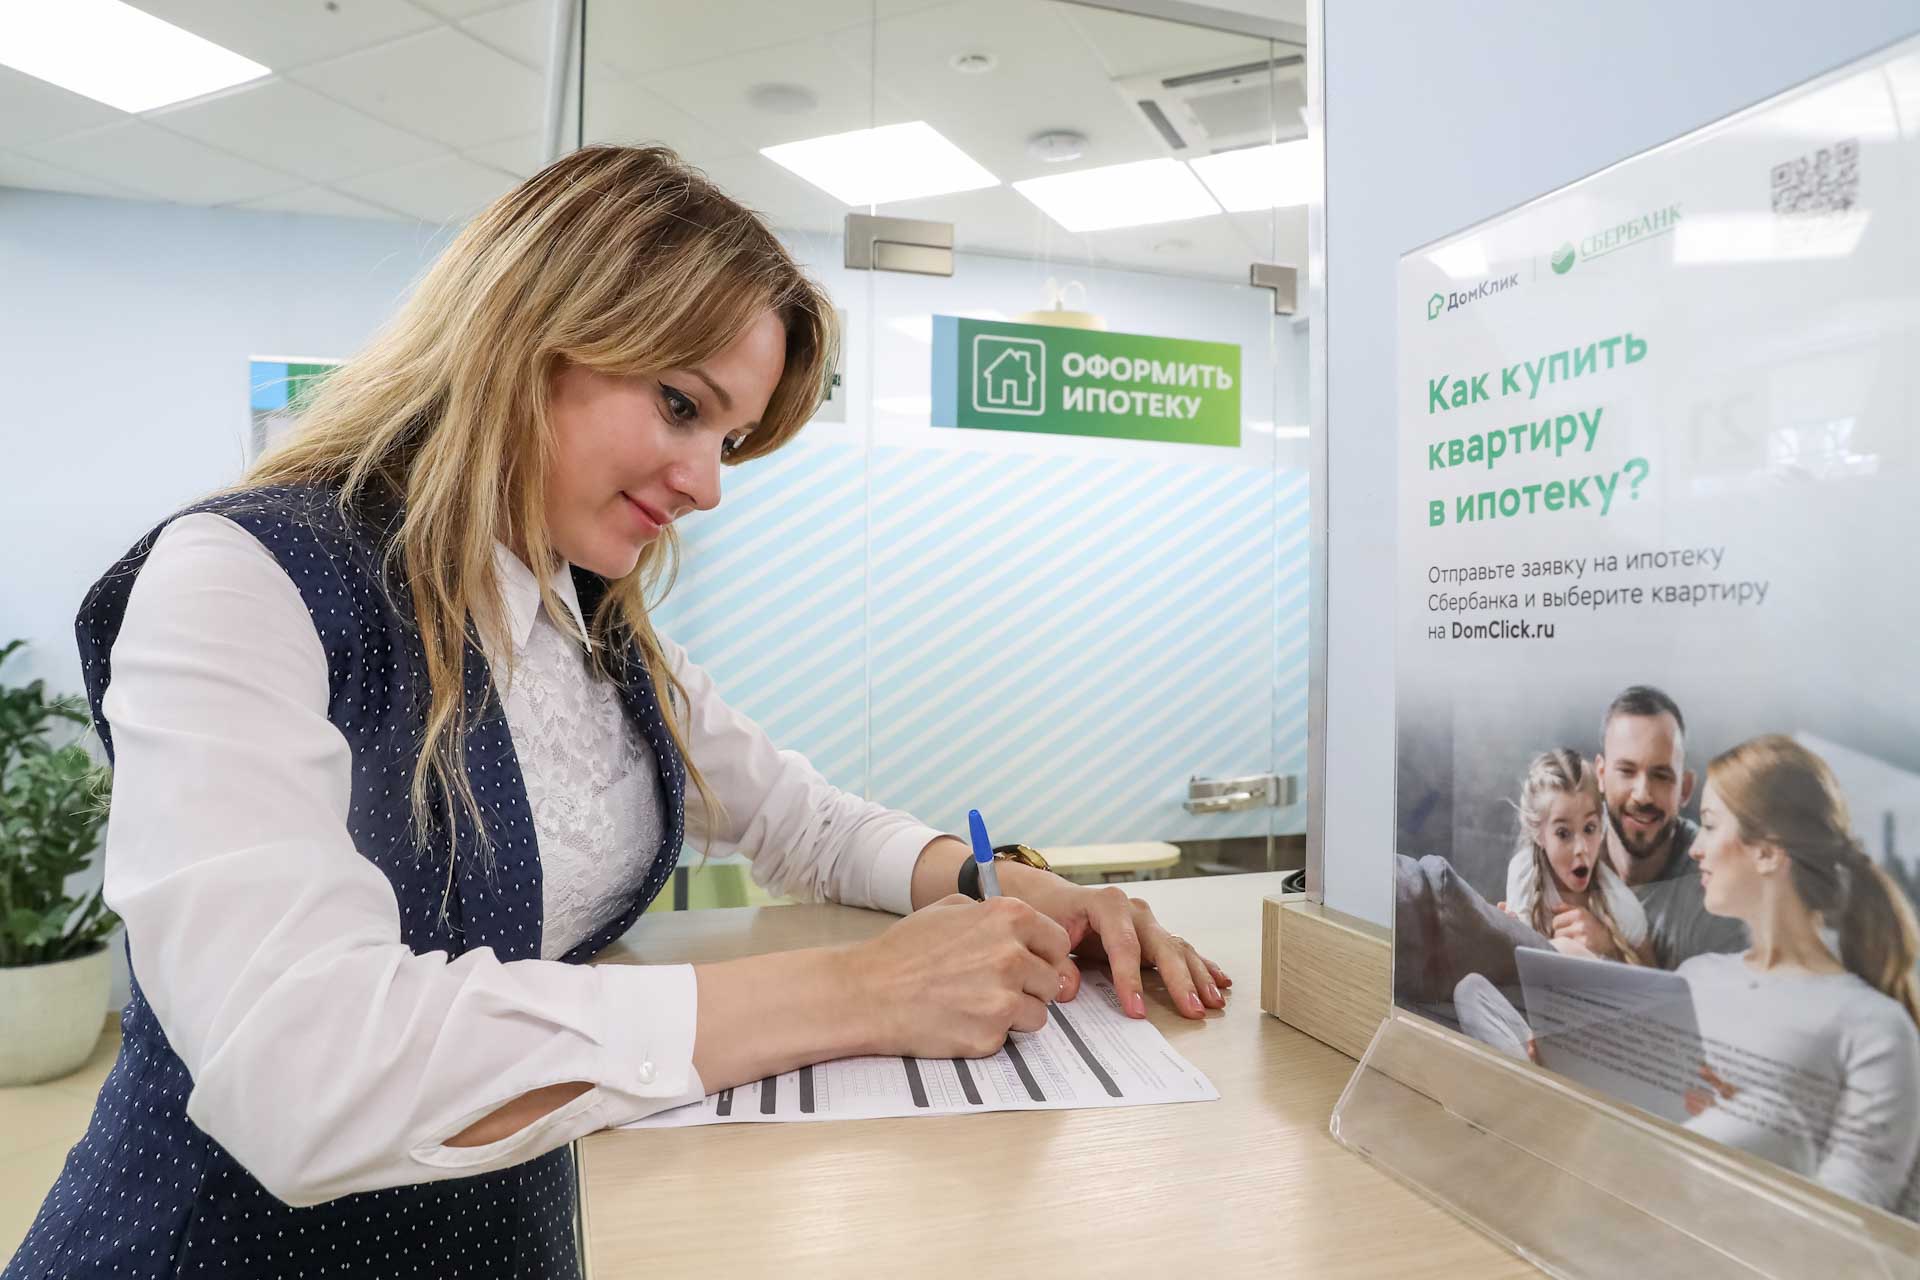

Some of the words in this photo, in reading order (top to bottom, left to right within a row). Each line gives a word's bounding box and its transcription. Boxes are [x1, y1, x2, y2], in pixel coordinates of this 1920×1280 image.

[1580, 202, 1683, 258] СБЕРБАНК
[1447, 272, 1519, 312] ДомКлик
[1061, 351, 1234, 390] ОФОРМИТЬ
[1428, 370, 1490, 414] Как
[1501, 332, 1648, 400] купить
[1061, 385, 1202, 420] ИПОТЕКУ
[1428, 405, 1603, 471] квартиру
[1428, 500, 1446, 527] в
[1455, 457, 1650, 523] ипотеку?
[1428, 562, 1516, 586] Отправьте
[1520, 556, 1586, 579] заявку
[1593, 551, 1619, 573] на
[1625, 546, 1726, 572] ипотеку
[1428, 592, 1518, 614] Сбербанка
[1524, 592, 1537, 609] и
[1542, 583, 1644, 612] выберите
[1651, 578, 1769, 607] квартиру
[1428, 626, 1447, 640] на
[1451, 619, 1555, 641] DomClick.ru
